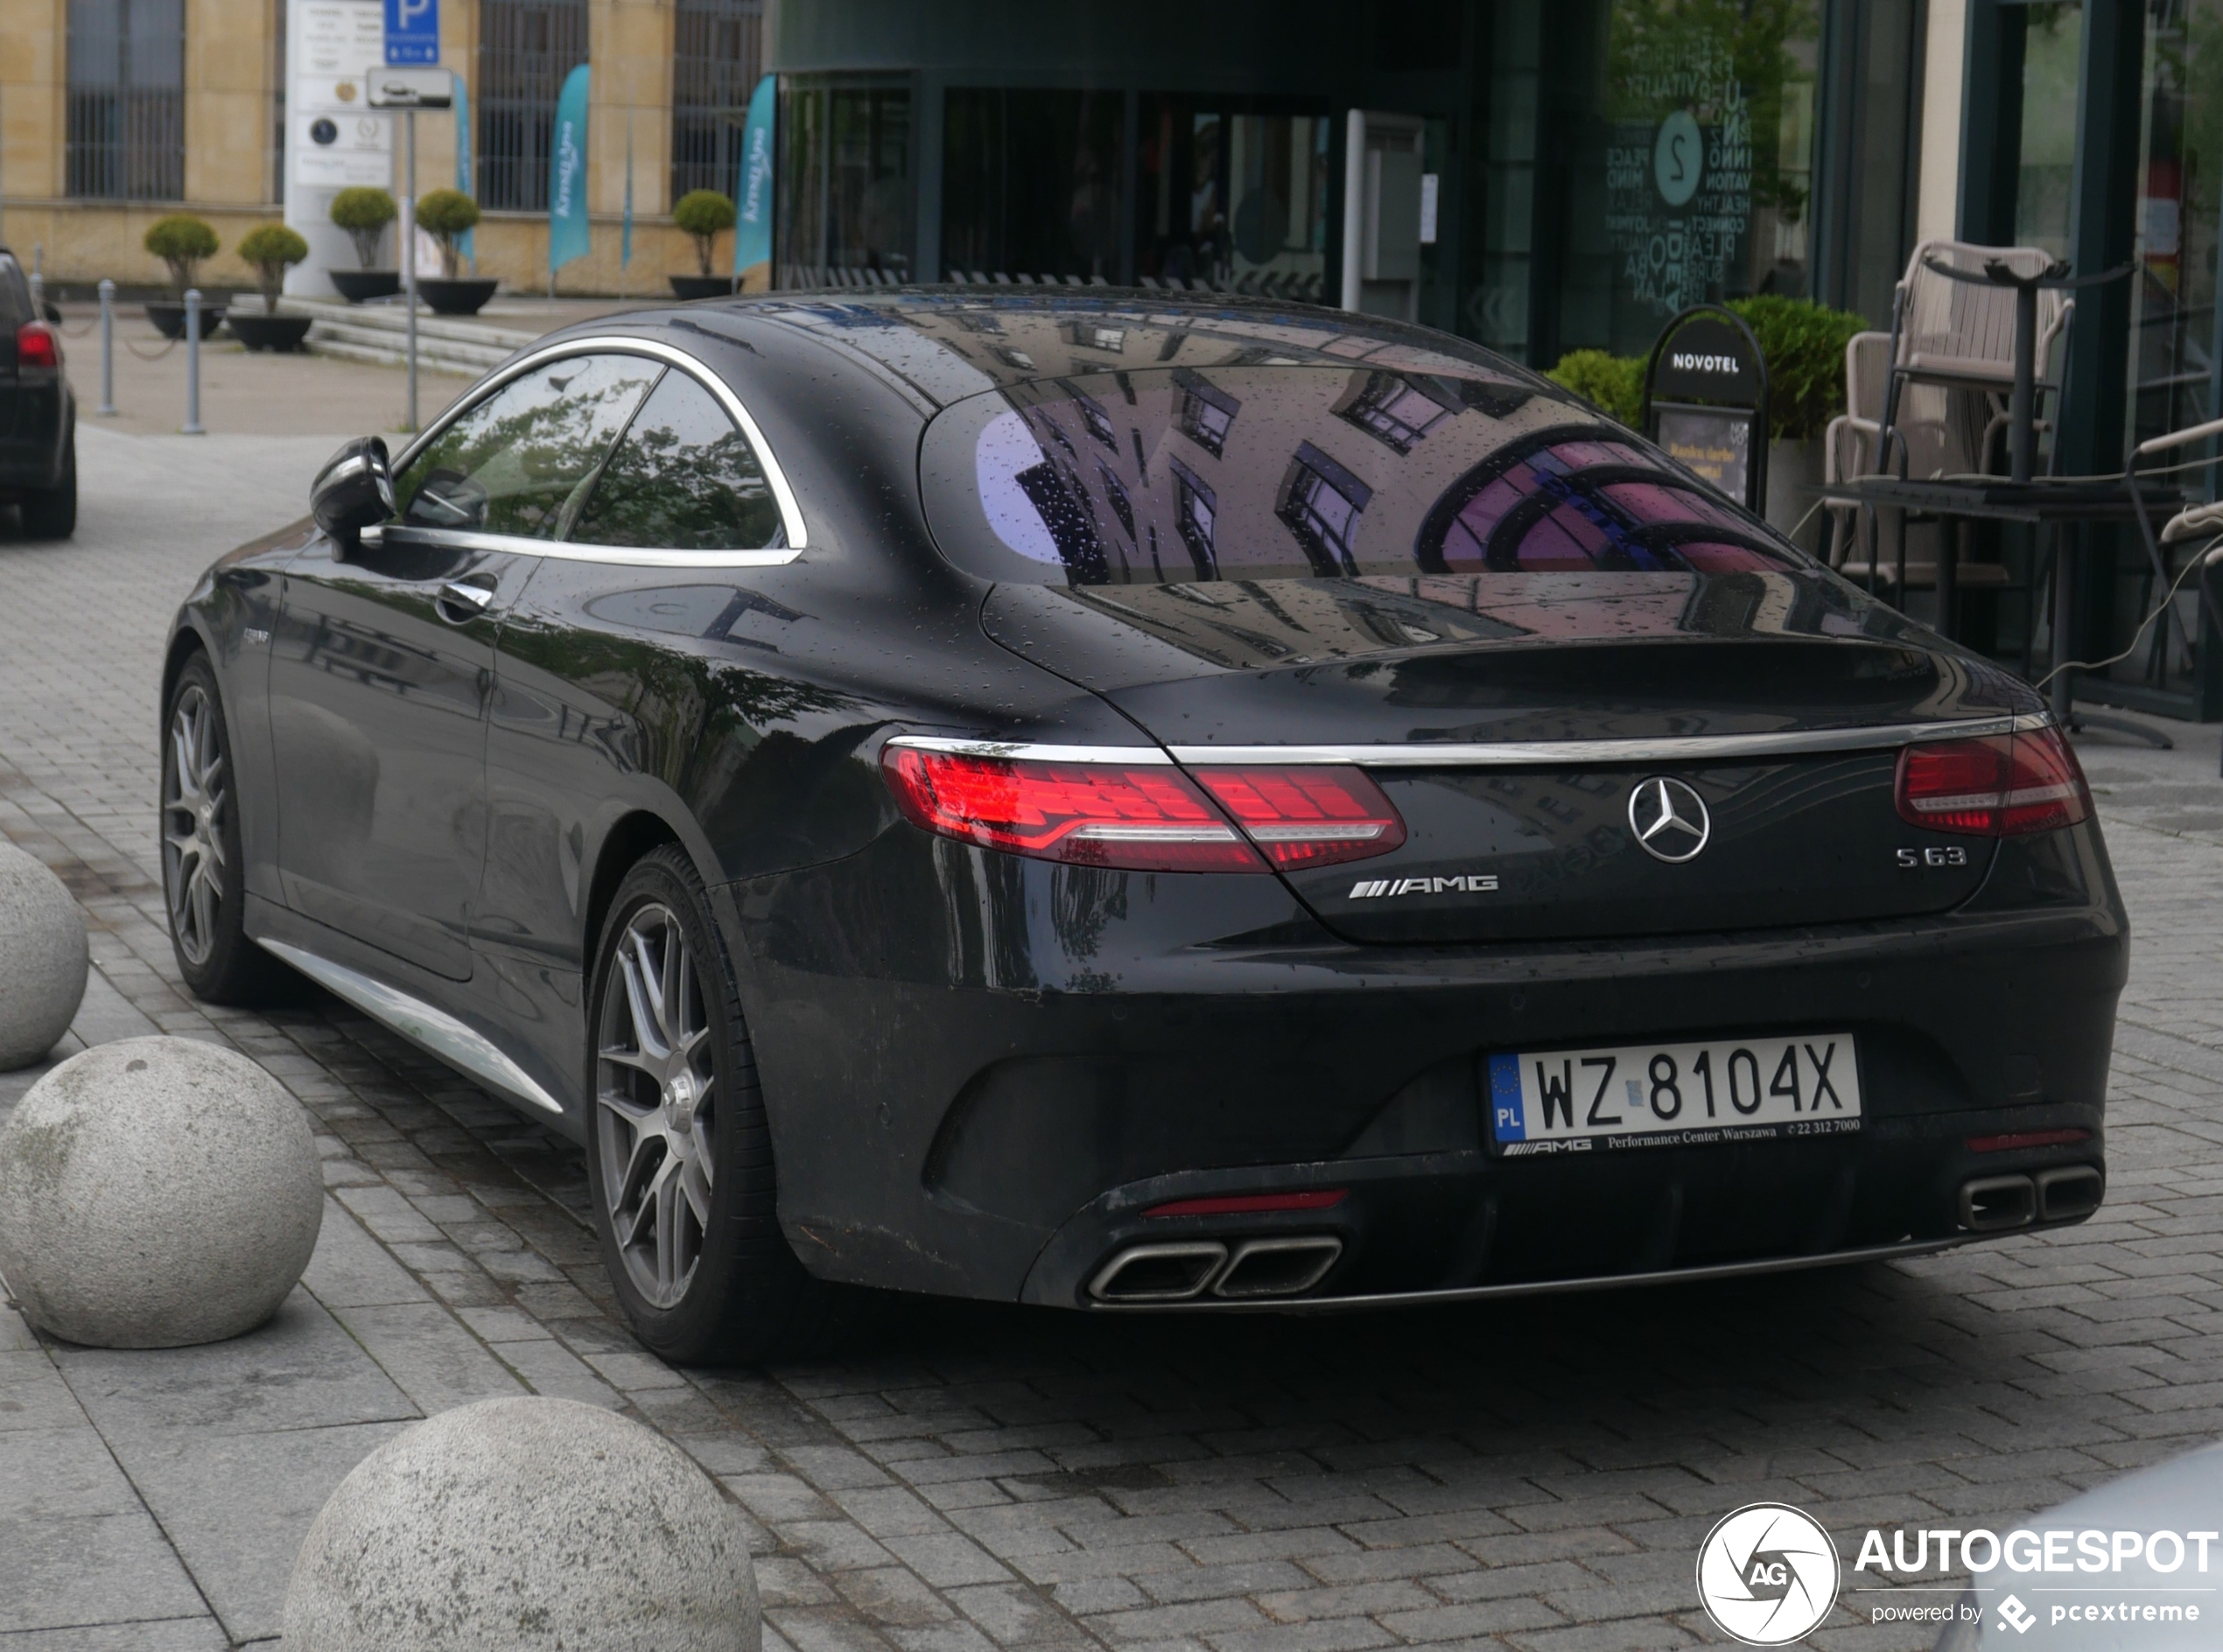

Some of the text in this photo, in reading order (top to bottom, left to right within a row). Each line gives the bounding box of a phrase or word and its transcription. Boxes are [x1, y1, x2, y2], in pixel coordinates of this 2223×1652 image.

[398, 0, 430, 30] P
[1673, 353, 1740, 373] NOVOTEL
[1896, 846, 1967, 868] S 63
[1535, 1042, 1842, 1130] WZ 8104X
[1497, 1109, 1520, 1128] PL
[1608, 1119, 1861, 1149] Performance Center Warszawa 22 312 7000
